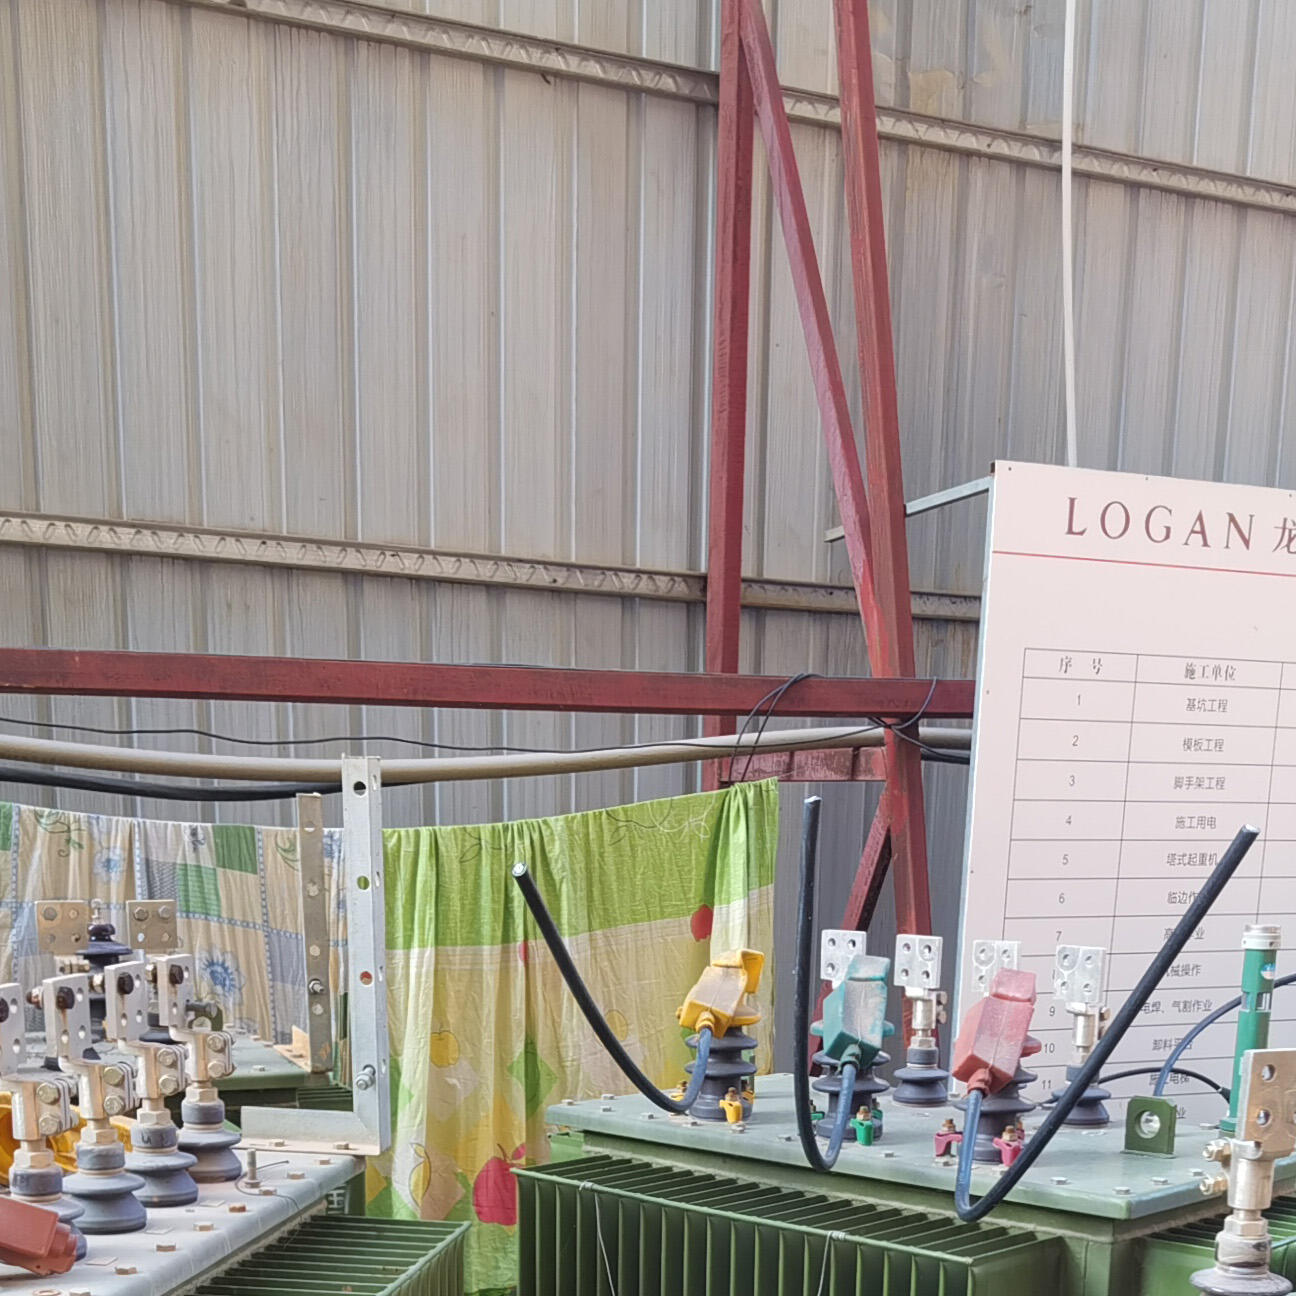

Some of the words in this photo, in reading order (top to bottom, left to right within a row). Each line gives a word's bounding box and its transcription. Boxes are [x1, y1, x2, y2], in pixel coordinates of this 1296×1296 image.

[1065, 497, 1256, 550] LOGAN
[1183, 661, 1238, 682] 施工单位
[1076, 693, 1082, 706] 1
[1185, 697, 1228, 713] 基坑工程
[1072, 735, 1079, 747] 2
[1183, 738, 1225, 753] 模板工程
[1068, 775, 1075, 787] 3
[1173, 776, 1226, 791] 脚手架工程
[1065, 815, 1072, 826] 4
[1175, 815, 1217, 831] 施工用电
[1062, 854, 1069, 866] 5
[1166, 852, 1218, 868] 塔式起重机
[1058, 892, 1065, 904] 6
[1055, 930, 1062, 942] 7
[1049, 1006, 1056, 1017] 9
[1044, 1043, 1055, 1055] 10
[1041, 1080, 1052, 1090] 11
